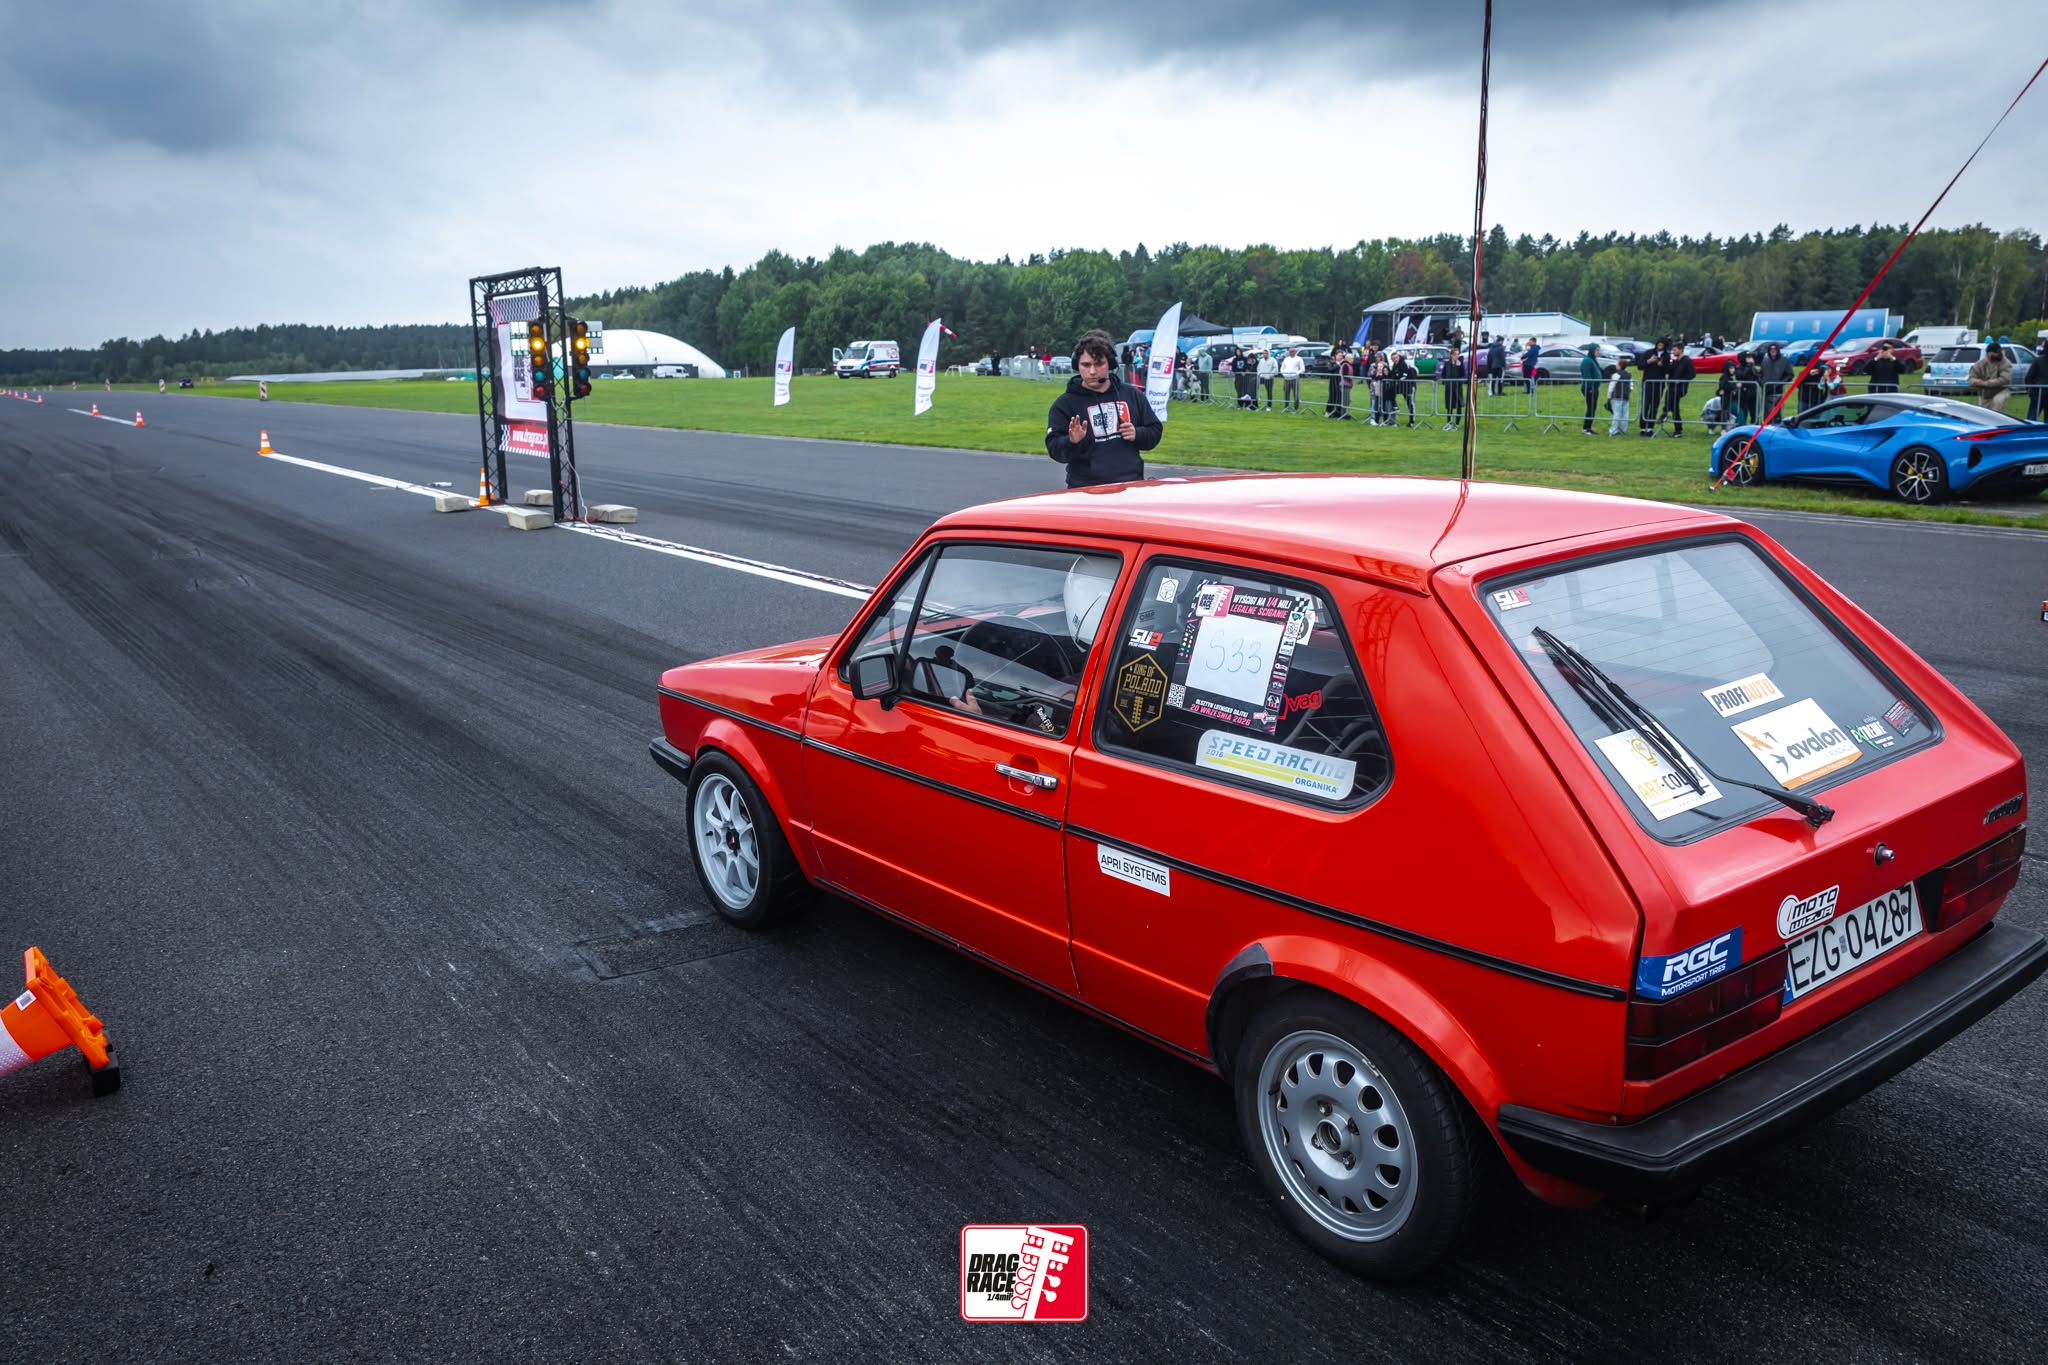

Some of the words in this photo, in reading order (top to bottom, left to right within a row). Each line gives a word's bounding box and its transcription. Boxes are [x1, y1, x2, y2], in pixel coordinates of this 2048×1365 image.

[1230, 604, 1258, 615] LEGALNE
[1256, 597, 1267, 607] NA
[1266, 597, 1279, 608] 1/4
[1277, 599, 1293, 609] MILI
[1123, 673, 1163, 694] POLAND
[1133, 663, 1148, 676] KING
[1146, 667, 1156, 678] OF
[1190, 703, 1200, 712] 20
[1206, 748, 1225, 758] 2016
[1208, 735, 1271, 761] SPEED
[1273, 751, 1347, 780] RACING
[1786, 727, 1847, 760] avalon
[1295, 777, 1338, 794] ORGANIKA
[1101, 854, 1121, 870] APRI
[1123, 862, 1167, 886] SYSTEMS
[1792, 887, 1838, 919] MOTO
[1789, 904, 1835, 934] WIZJA
[1788, 925, 1840, 991] EZG
[1845, 884, 1912, 960] 04287
[1663, 933, 1731, 982] RGC
[1661, 972, 1709, 997] MOTORSPORT
[1709, 963, 1726, 976] TIRES
